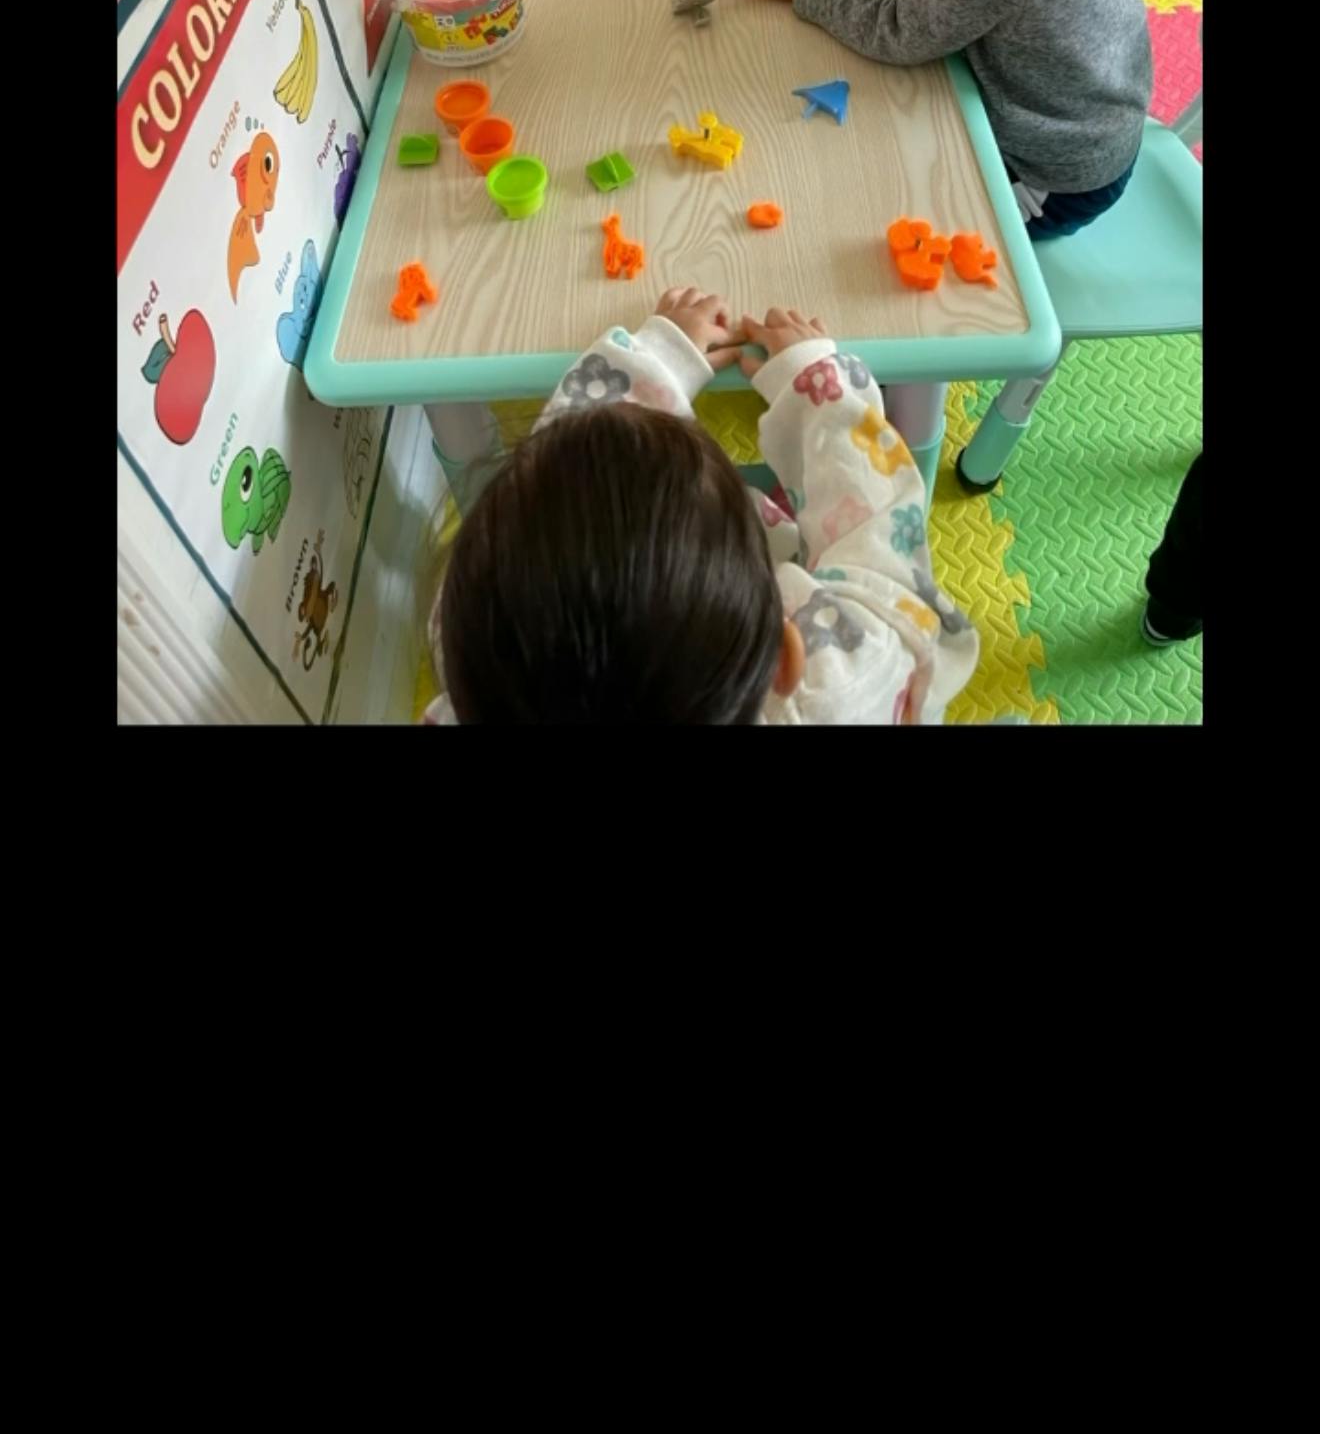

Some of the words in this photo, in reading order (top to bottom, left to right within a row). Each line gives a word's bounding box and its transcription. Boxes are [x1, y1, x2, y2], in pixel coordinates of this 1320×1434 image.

[209, 100, 241, 169] Orange
[317, 119, 336, 169] Purple
[275, 250, 292, 295] Blue
[132, 280, 160, 336] Red
[209, 412, 239, 486] Green
[285, 538, 308, 614] Brown
